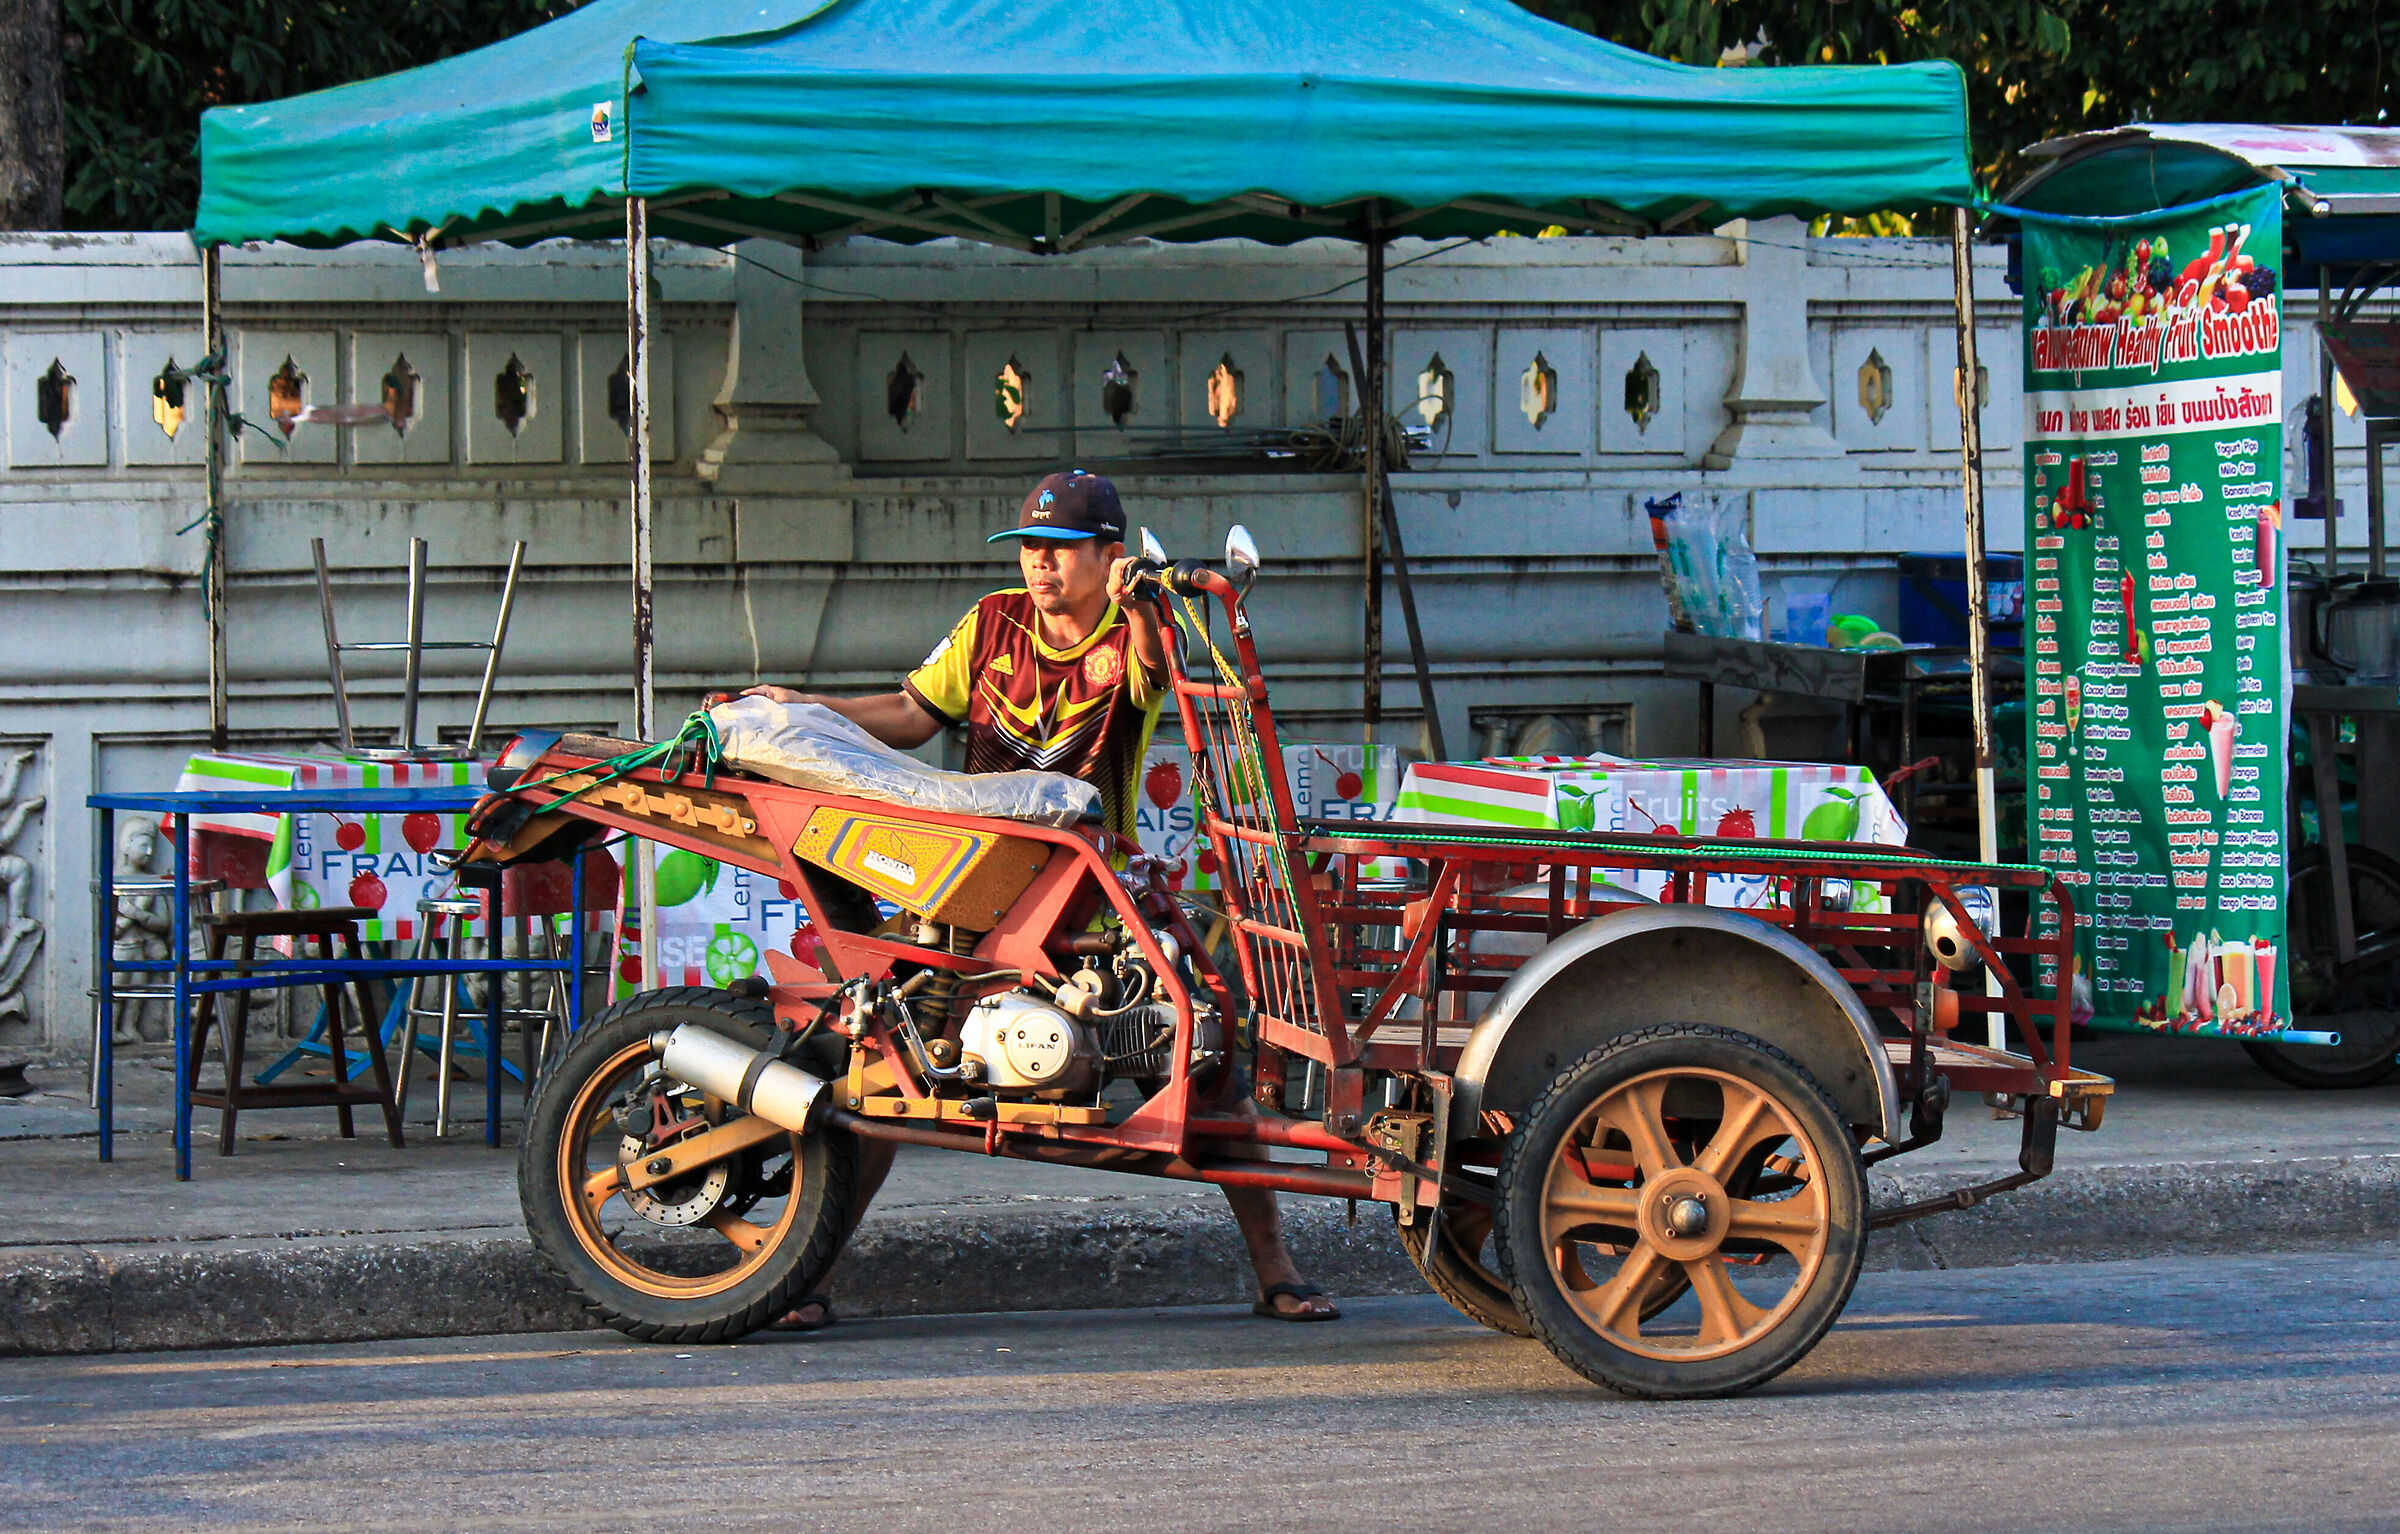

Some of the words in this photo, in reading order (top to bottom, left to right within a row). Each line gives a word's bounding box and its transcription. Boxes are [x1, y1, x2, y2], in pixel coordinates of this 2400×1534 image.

[2115, 316, 2165, 374] Healthy
[2164, 309, 2199, 363] Fruit
[2126, 399, 2150, 429] ร้อน
[2156, 394, 2175, 426] เย็น
[1626, 789, 1728, 821] Fruits
